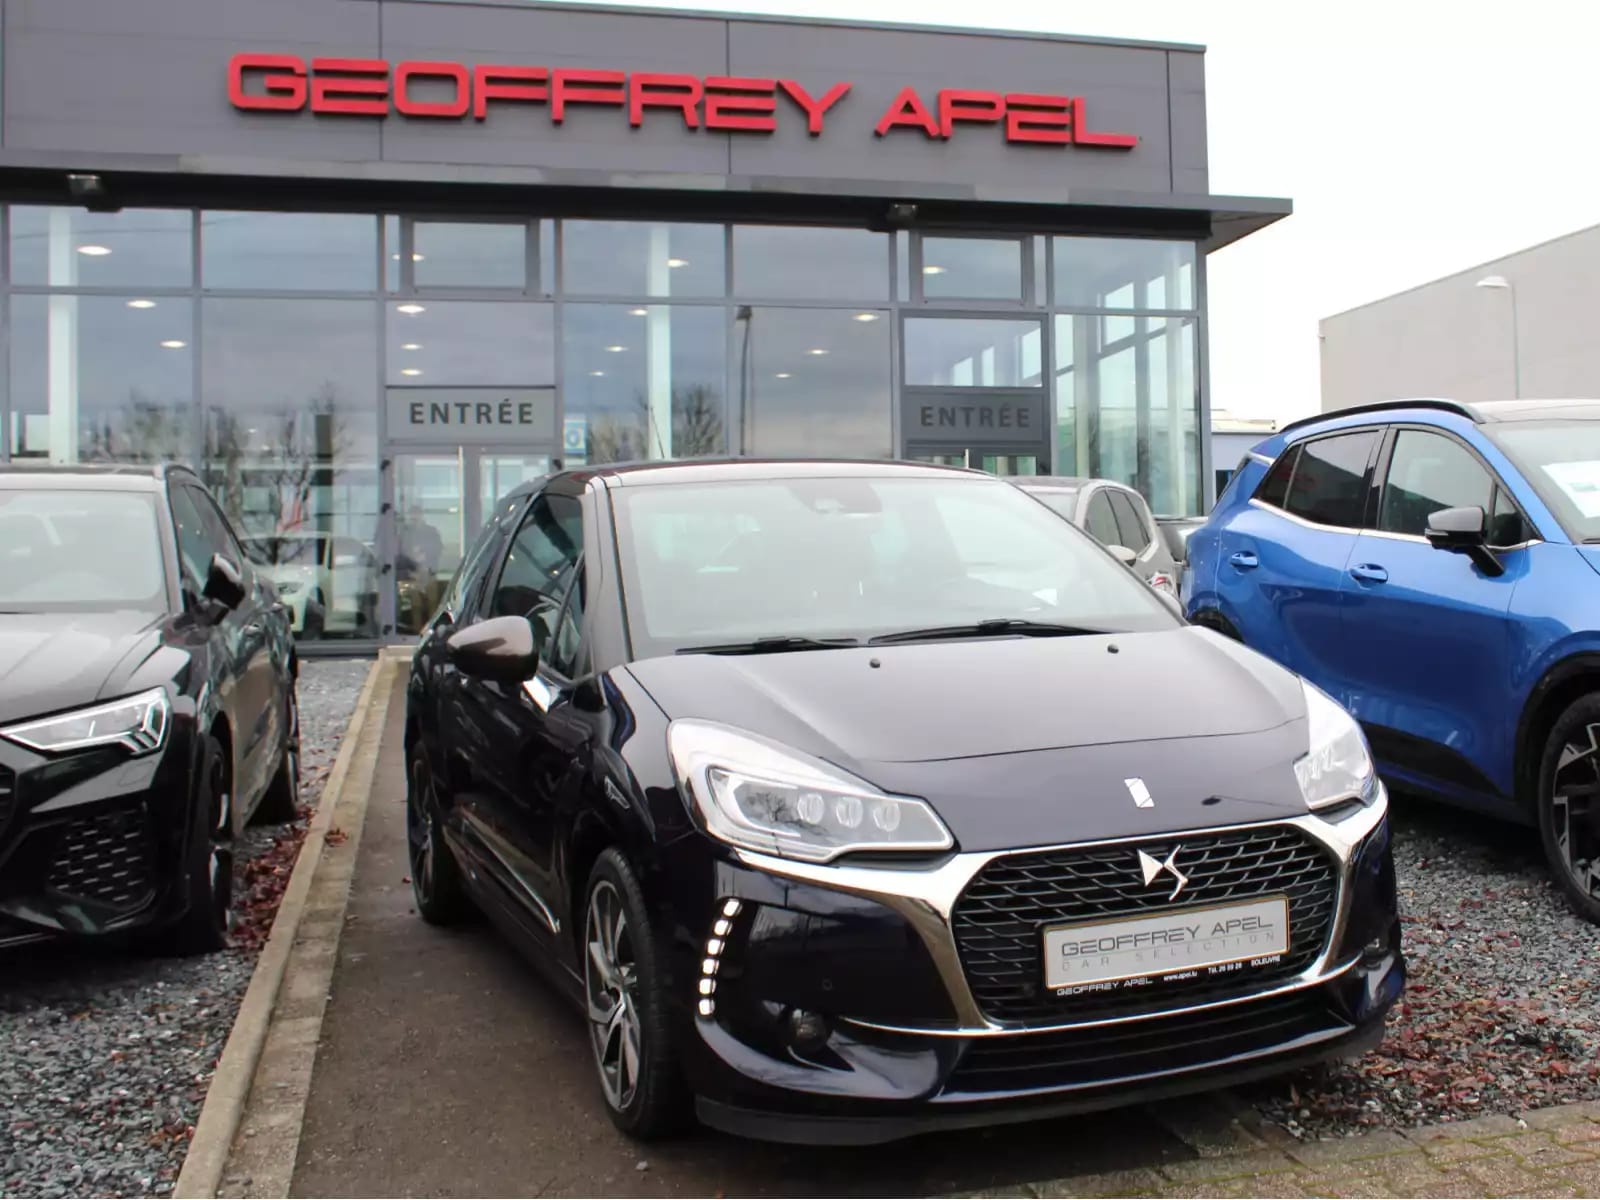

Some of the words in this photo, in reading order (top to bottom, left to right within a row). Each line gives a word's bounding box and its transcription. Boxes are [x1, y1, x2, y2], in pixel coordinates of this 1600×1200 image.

[228, 53, 852, 137] GEOFFREY
[873, 86, 1137, 151] APEL
[410, 398, 534, 424] ENTRÉE
[920, 403, 1030, 428] ENTRÉE
[1062, 924, 1200, 956] GEOFFREY
[1211, 916, 1273, 936] APEL
[1062, 956, 1109, 971] CAR
[1135, 931, 1274, 962] SELECTION
[1057, 982, 1119, 996] GEOFFREY
[1124, 977, 1153, 988] APEL
